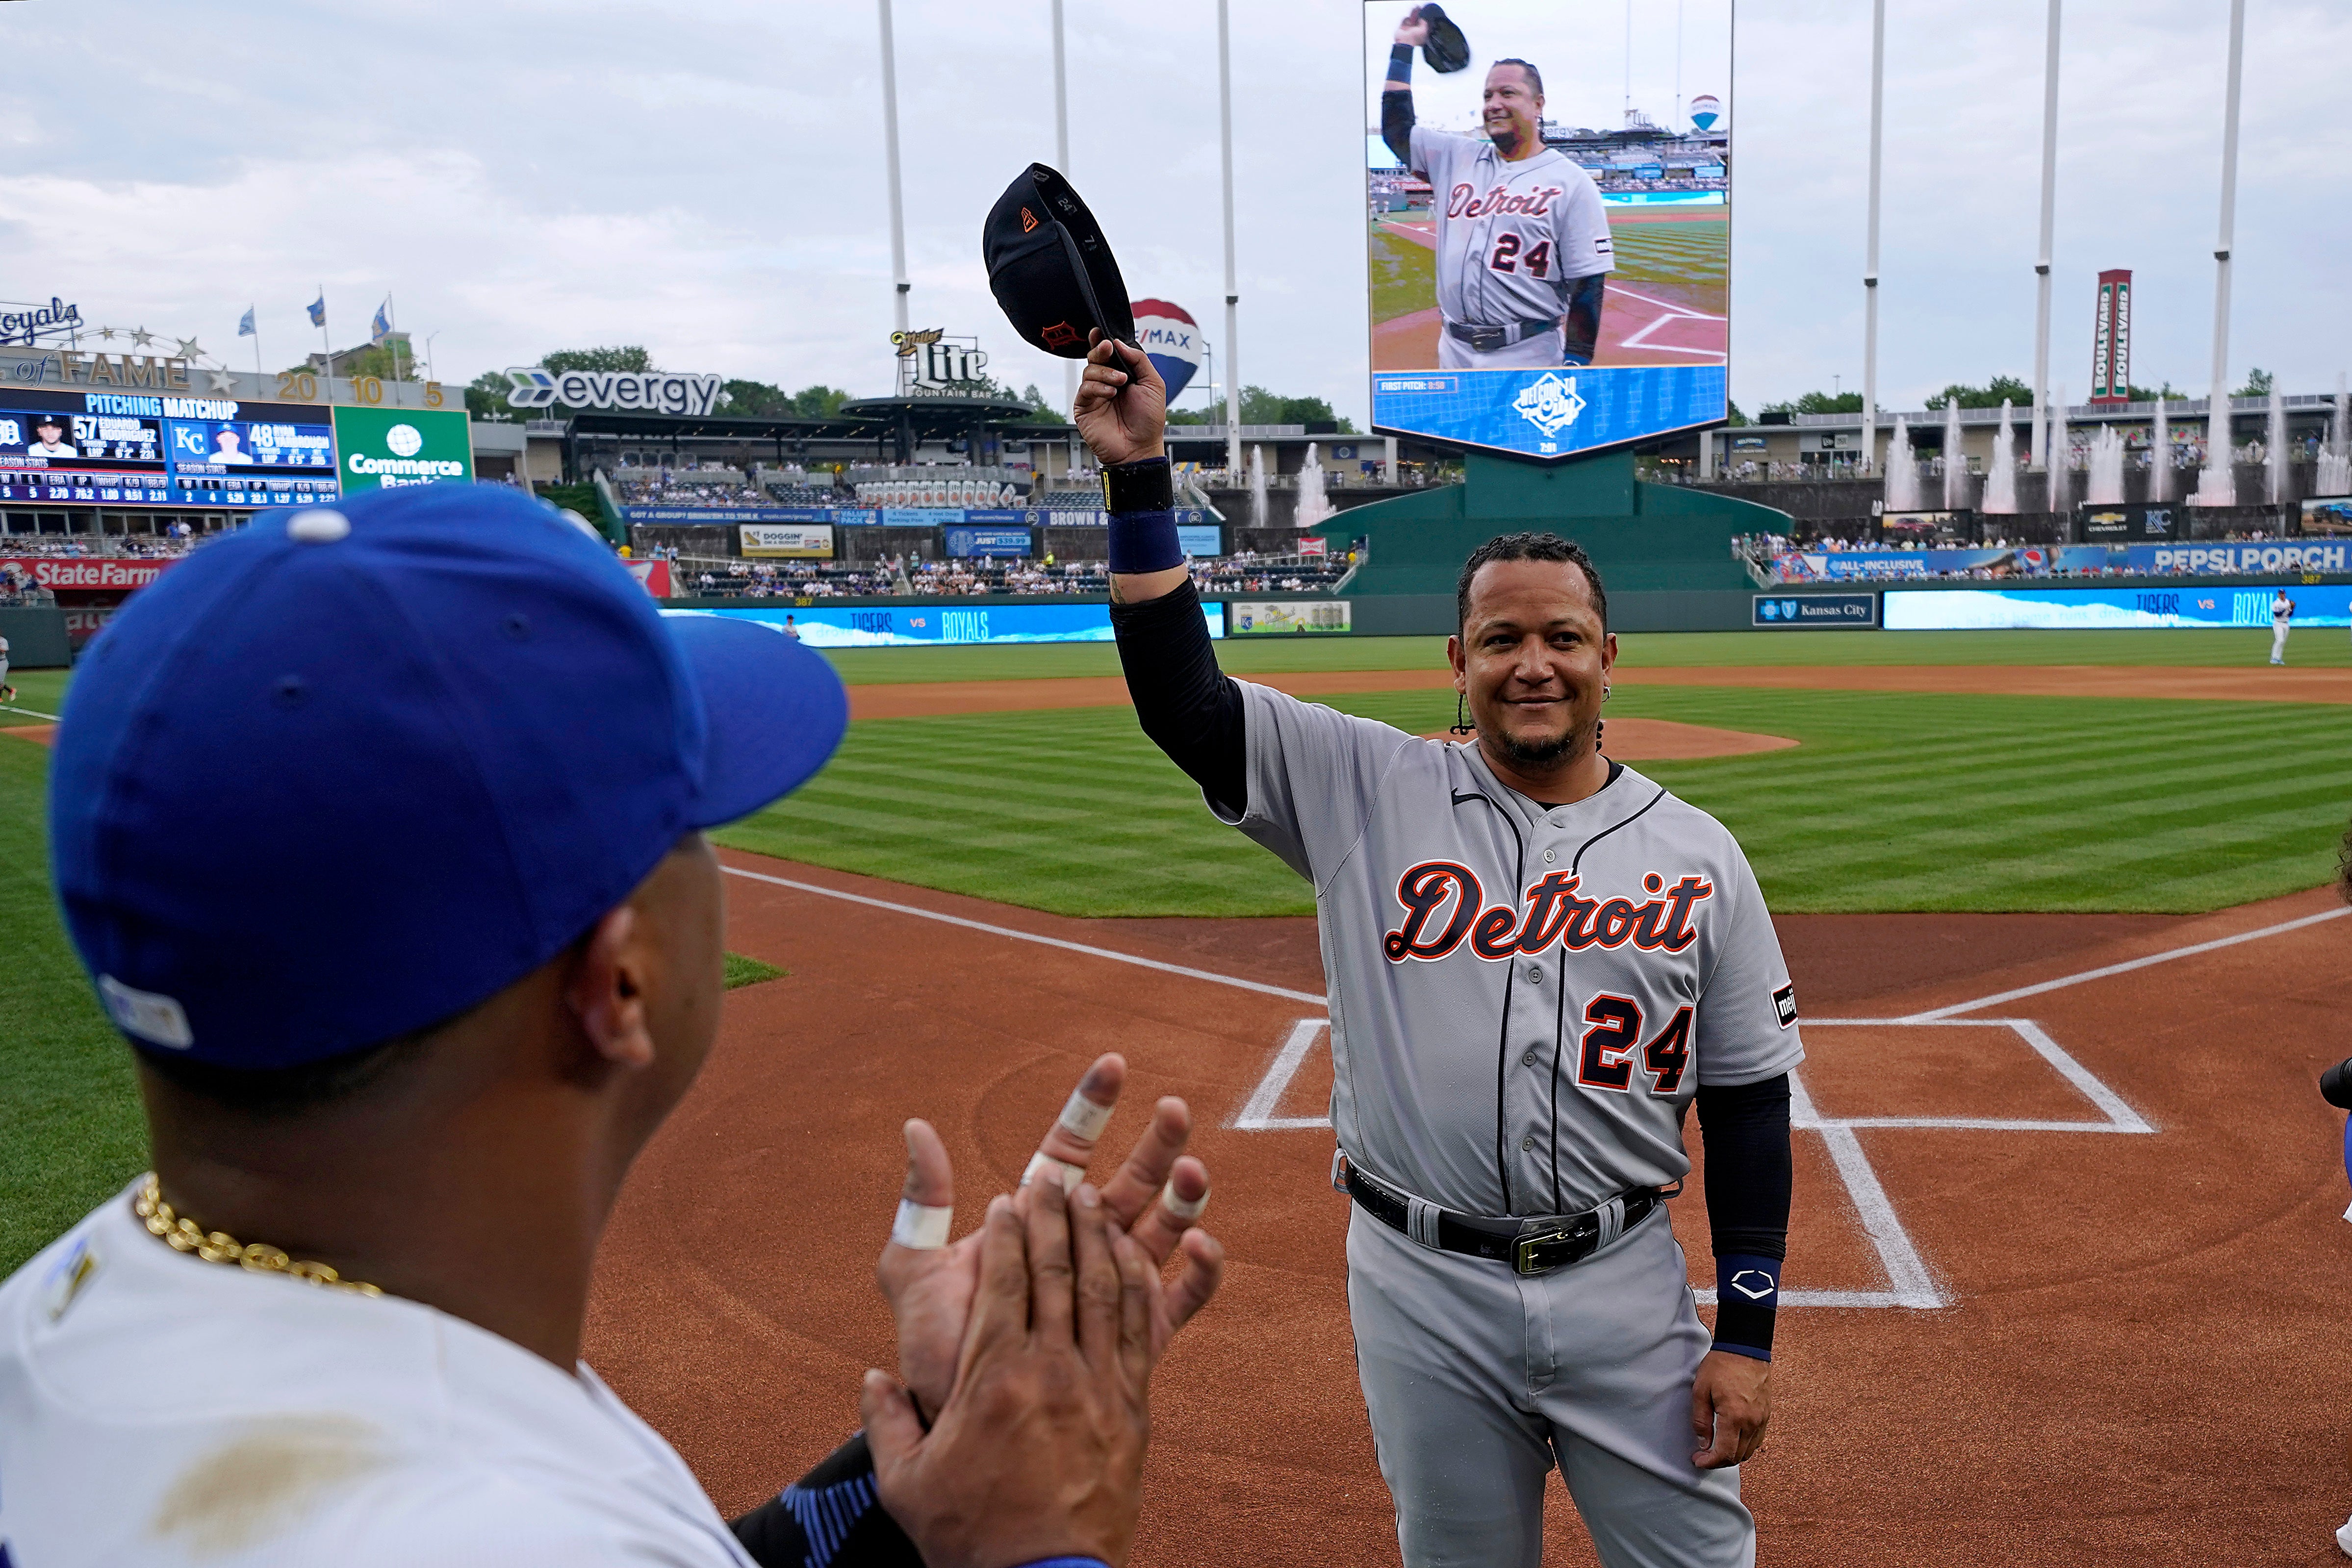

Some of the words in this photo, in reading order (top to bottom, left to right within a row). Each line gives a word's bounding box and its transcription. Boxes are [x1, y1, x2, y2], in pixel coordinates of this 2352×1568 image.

[1448, 183, 1561, 221] Detroit
[1490, 232, 1552, 279] 24
[0, 297, 78, 346] oyals
[2094, 292, 2110, 388] BOULEVARD
[2115, 291, 2128, 387] BOULEVARD
[16, 353, 55, 388] of
[60, 351, 193, 391] FAME
[914, 343, 988, 390] Lite
[277, 372, 317, 401] 20
[350, 376, 383, 405] 10
[425, 382, 443, 407] 5
[562, 377, 716, 414] evergy
[971, 391, 992, 399] BAR
[1381, 382, 1402, 391] FIRST
[1520, 381, 1561, 406] WELCOME
[1564, 377, 1576, 395] TO
[85, 393, 162, 417] PITCHING
[163, 398, 239, 420] MATCHUP
[1537, 396, 1579, 426] City
[73, 416, 98, 440] 57
[174, 427, 205, 454] KC
[250, 424, 274, 447] 48
[25, 457, 49, 469] STATS
[177, 463, 205, 474] SEASON
[349, 453, 463, 476] Commerce
[1049, 512, 1095, 525] BROWN
[1839, 559, 1924, 571] ALL-INCLUSIVE
[2155, 549, 2234, 571] PEPSI
[2241, 546, 2345, 569] PORCH
[1801, 605, 1841, 615] Kansas
[1843, 605, 1866, 617] City
[2137, 594, 2179, 620] TIGERS
[850, 612, 894, 636] TIGERS
[943, 611, 988, 641] ROYALS
[1383, 859, 1714, 965] Detroit
[1575, 990, 1699, 1095] 24
